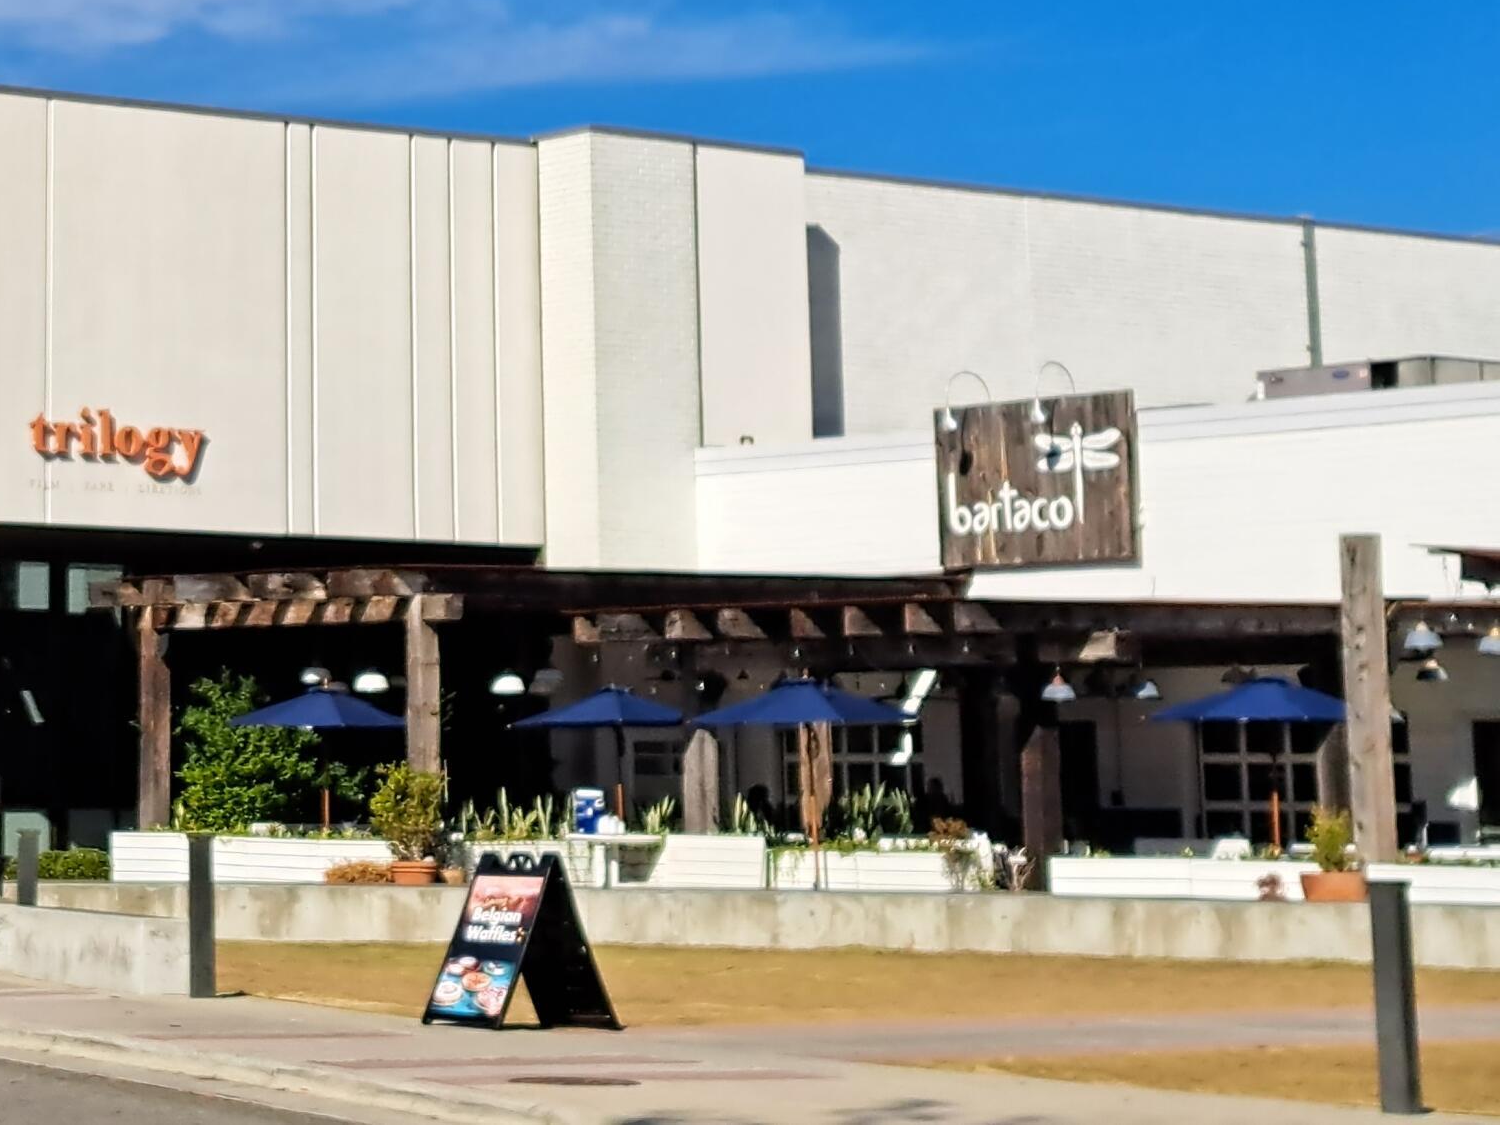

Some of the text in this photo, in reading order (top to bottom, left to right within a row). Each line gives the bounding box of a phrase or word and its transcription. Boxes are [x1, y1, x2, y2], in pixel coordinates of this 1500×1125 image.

[29, 406, 208, 480] trilogy
[948, 472, 1075, 536] bartaco
[465, 925, 518, 943] Waffles
[471, 906, 523, 925] Belgian
